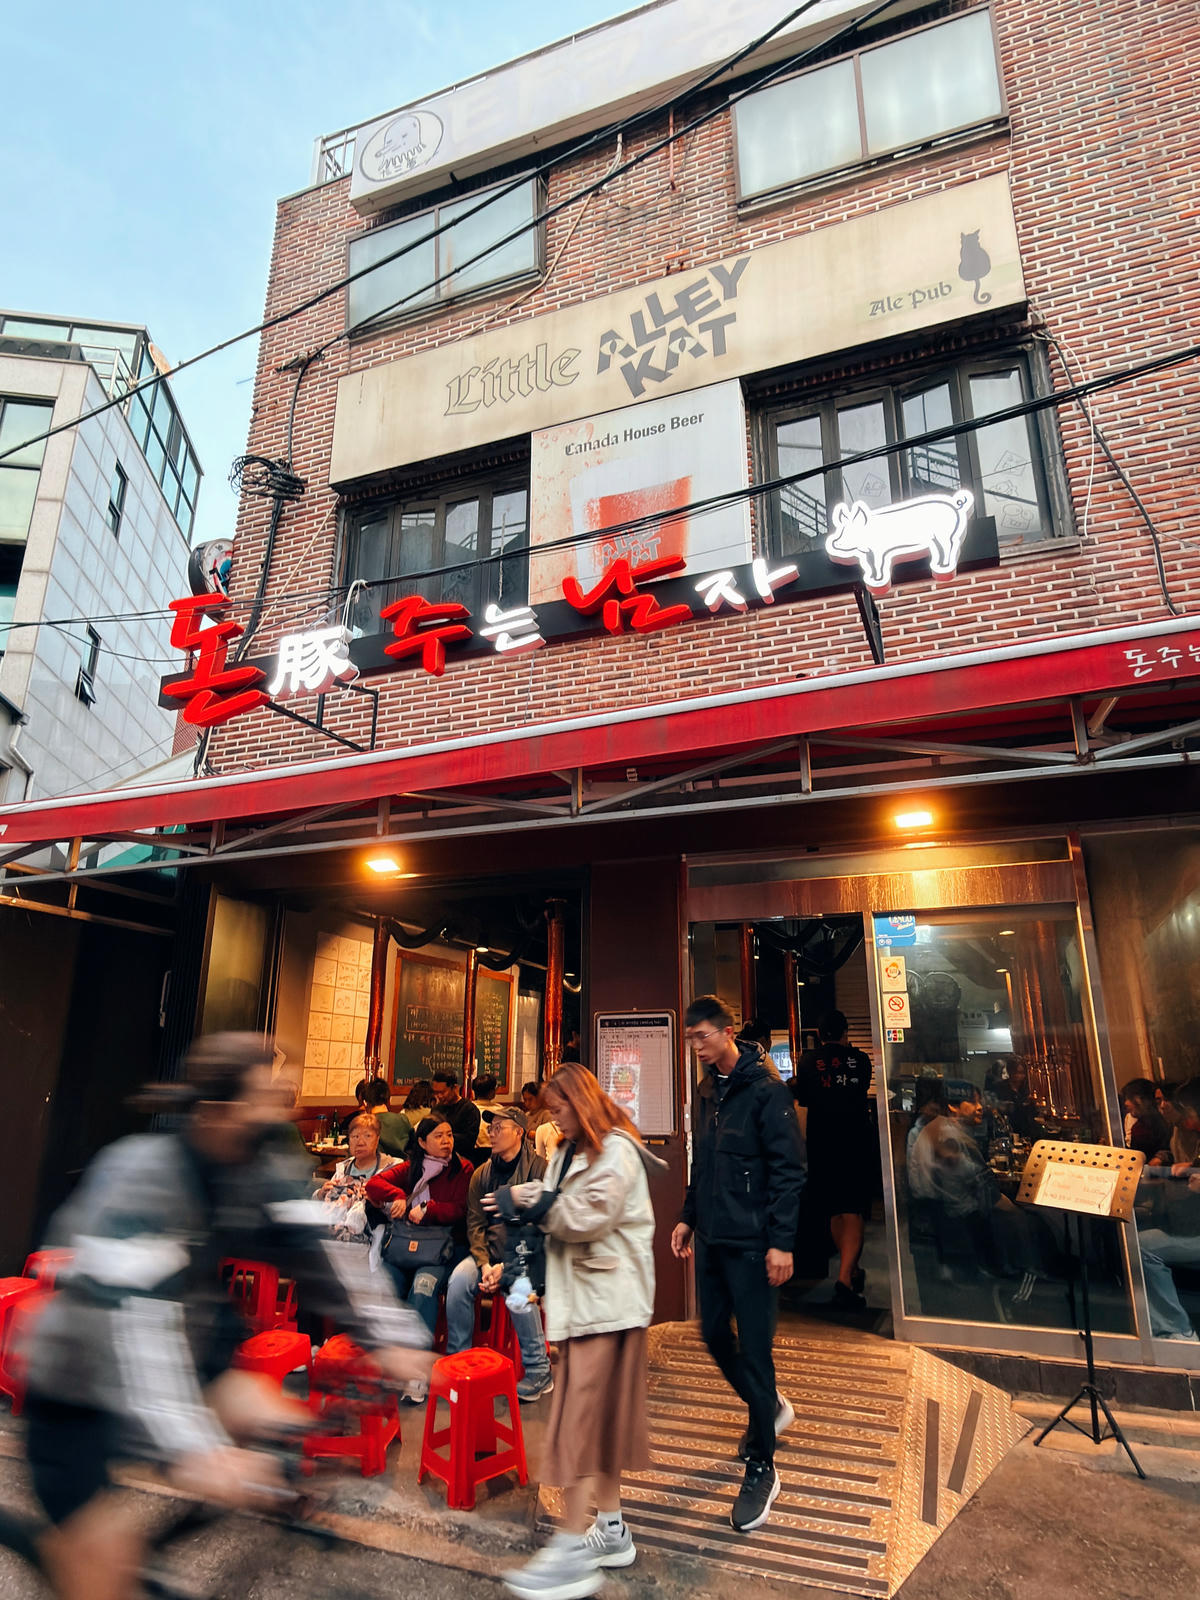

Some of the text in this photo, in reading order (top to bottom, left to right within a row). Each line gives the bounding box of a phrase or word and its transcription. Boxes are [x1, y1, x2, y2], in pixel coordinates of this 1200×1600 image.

[597, 256, 751, 375] ALLEY
[869, 281, 953, 317] Ale Pub
[444, 343, 582, 416] Little
[620, 312, 737, 398] KAT
[564, 411, 705, 456] Canada House Beer
